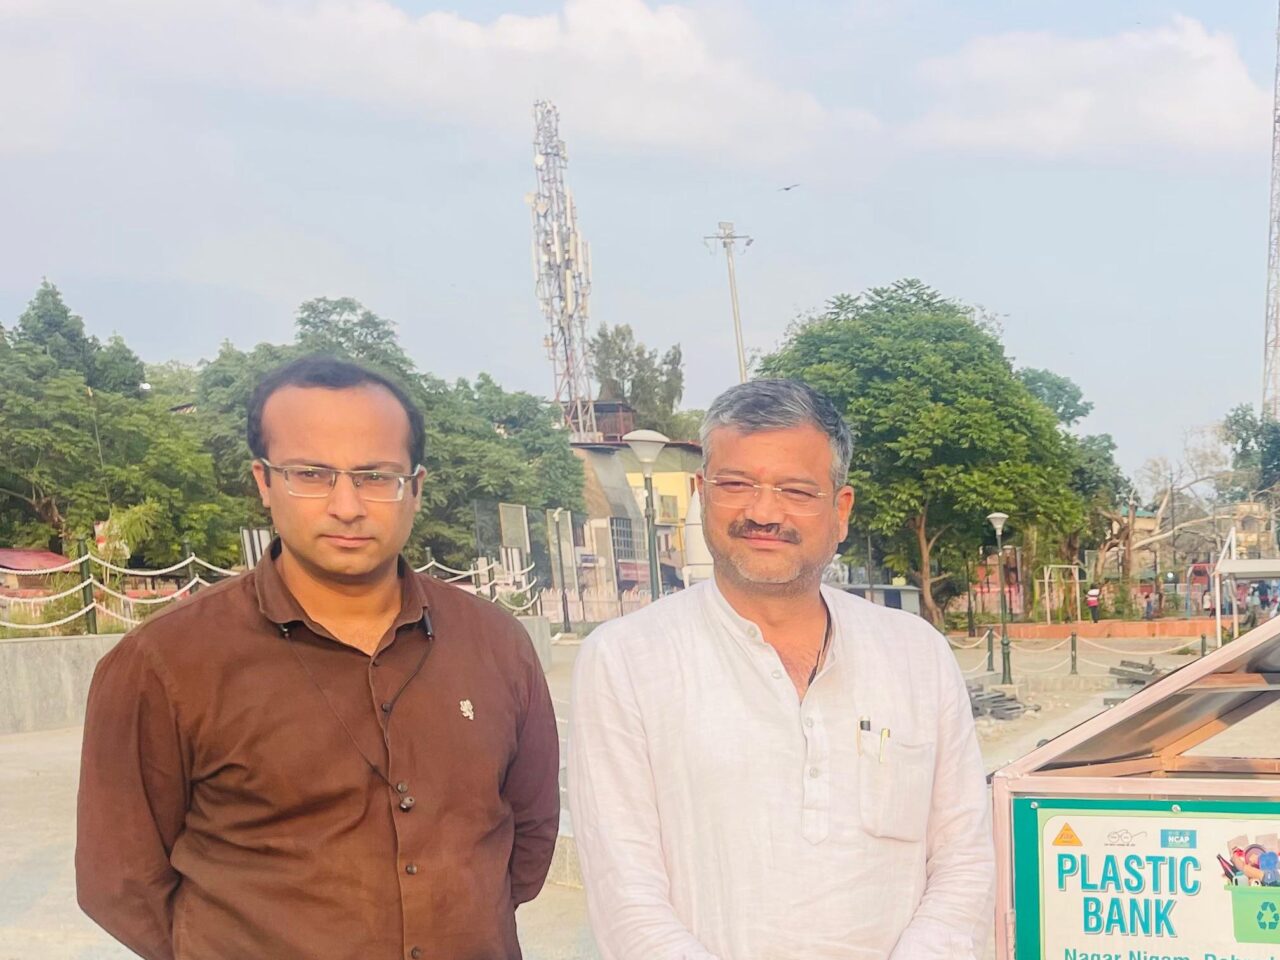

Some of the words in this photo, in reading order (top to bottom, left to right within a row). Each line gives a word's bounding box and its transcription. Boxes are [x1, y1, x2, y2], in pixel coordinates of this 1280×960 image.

[1168, 835, 1190, 844] NCAP
[1057, 853, 1201, 896] PLASTIC
[1083, 896, 1178, 937] BANK
